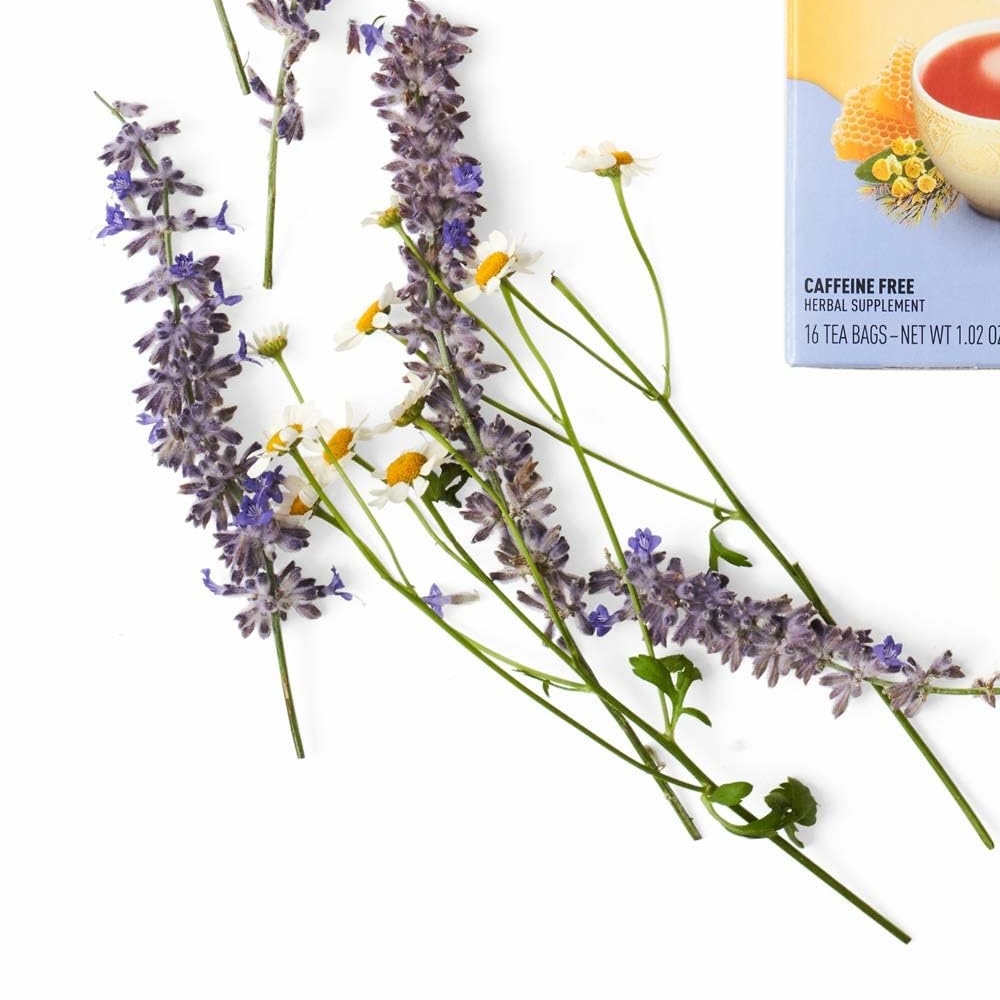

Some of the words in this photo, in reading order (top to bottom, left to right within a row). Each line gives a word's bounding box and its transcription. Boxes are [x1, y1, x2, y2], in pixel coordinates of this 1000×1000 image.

[804, 277, 875, 295] CAFFEINE
[878, 278, 915, 295] FREE
[804, 298, 848, 312] HERBAL
[851, 298, 926, 313] SUPPLEMENT
[805, 324, 819, 344] 16
[823, 324, 848, 345] TEA
[929, 324, 952, 345] WT
[956, 324, 984, 345] 1.02
